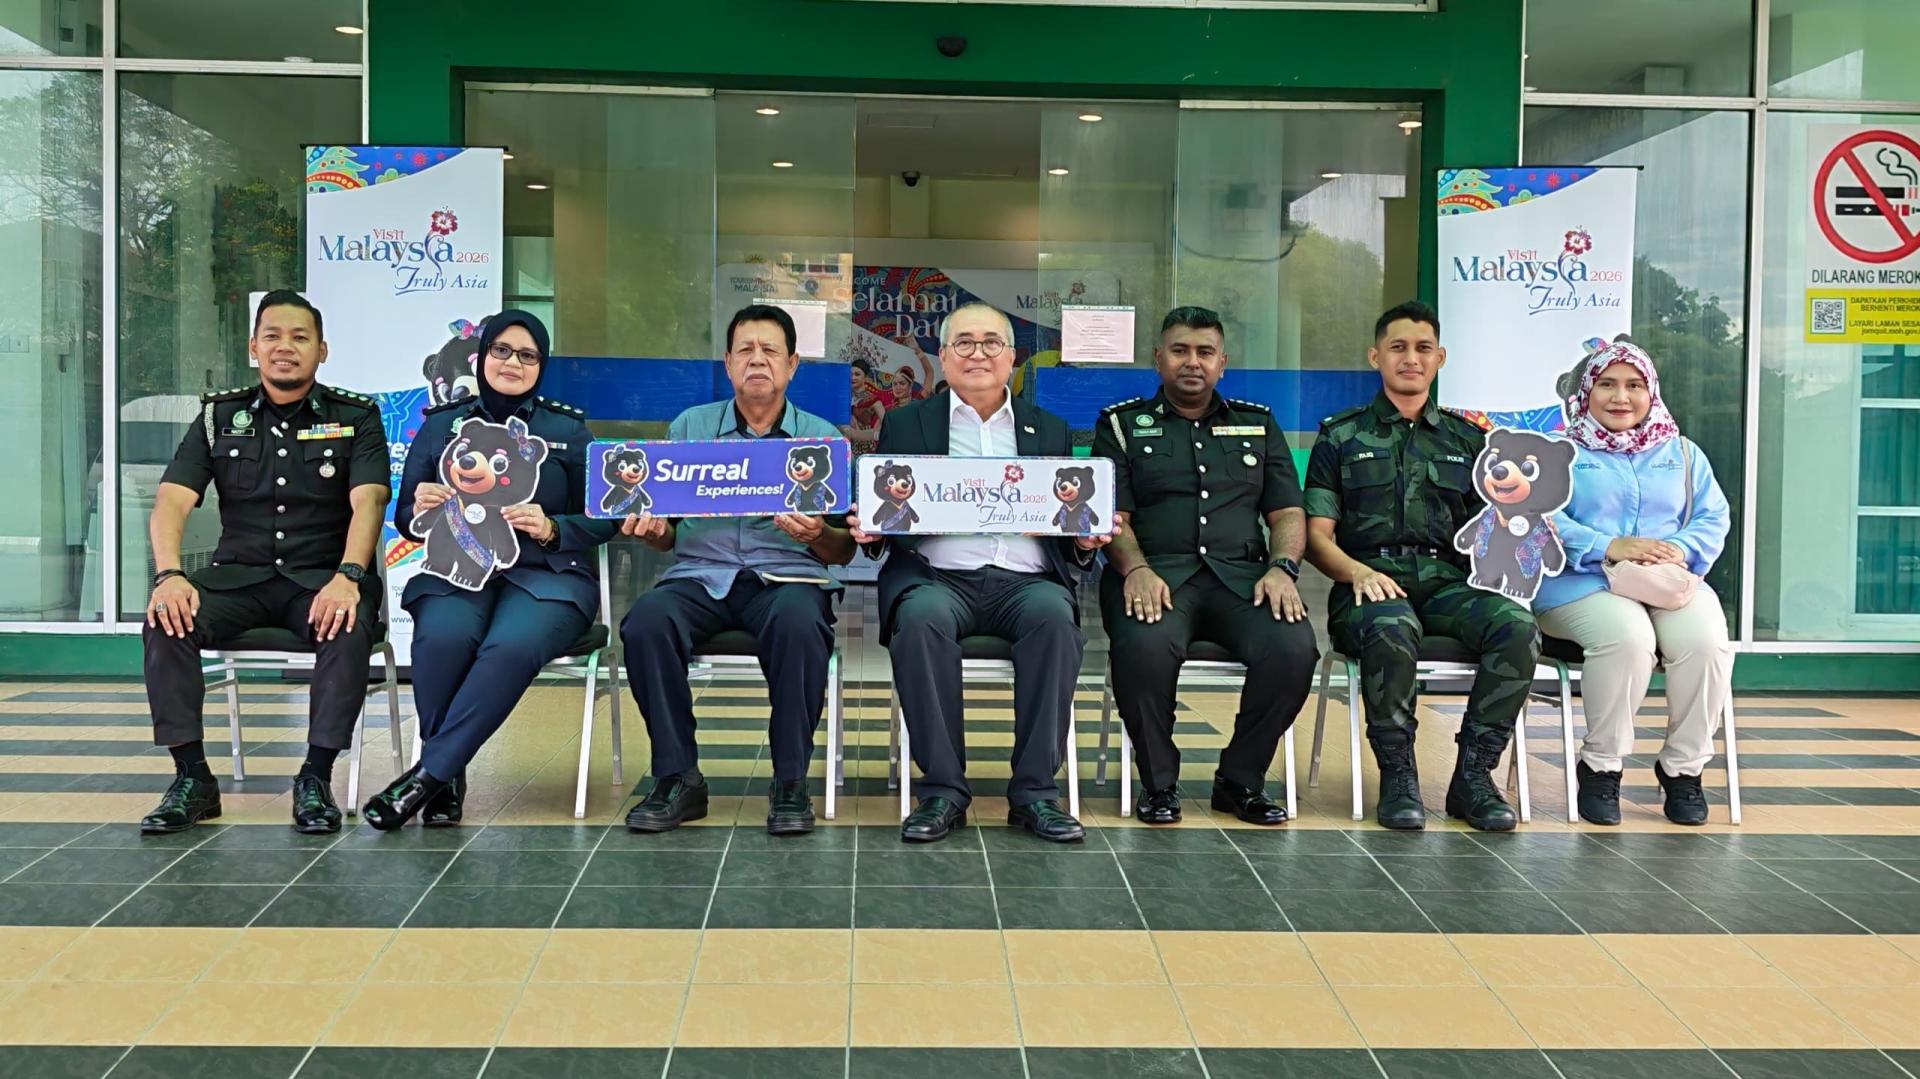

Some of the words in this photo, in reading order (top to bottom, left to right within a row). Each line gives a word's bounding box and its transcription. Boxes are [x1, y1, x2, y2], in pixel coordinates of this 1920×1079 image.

[373, 228, 404, 240] Visit
[318, 233, 454, 268] Malaysia
[456, 251, 489, 263] 2026
[1507, 249, 1537, 261] Visit
[395, 265, 448, 295] Truly
[451, 274, 488, 289] Asia
[1452, 255, 1588, 288] Malaysia
[1590, 270, 1622, 282] 2026
[1811, 269, 1875, 283] DILARANG
[1528, 285, 1581, 315] Truly
[1584, 293, 1620, 307] Asia
[896, 314, 941, 338] Dat
[653, 458, 749, 482] Surreal
[695, 483, 784, 499] Experiences!
[922, 482, 1022, 507] Malaysia
[1023, 495, 1048, 504] 2026
[963, 478, 985, 487] Visit
[978, 505, 1017, 527] Truly
[1019, 511, 1047, 522] Asia
